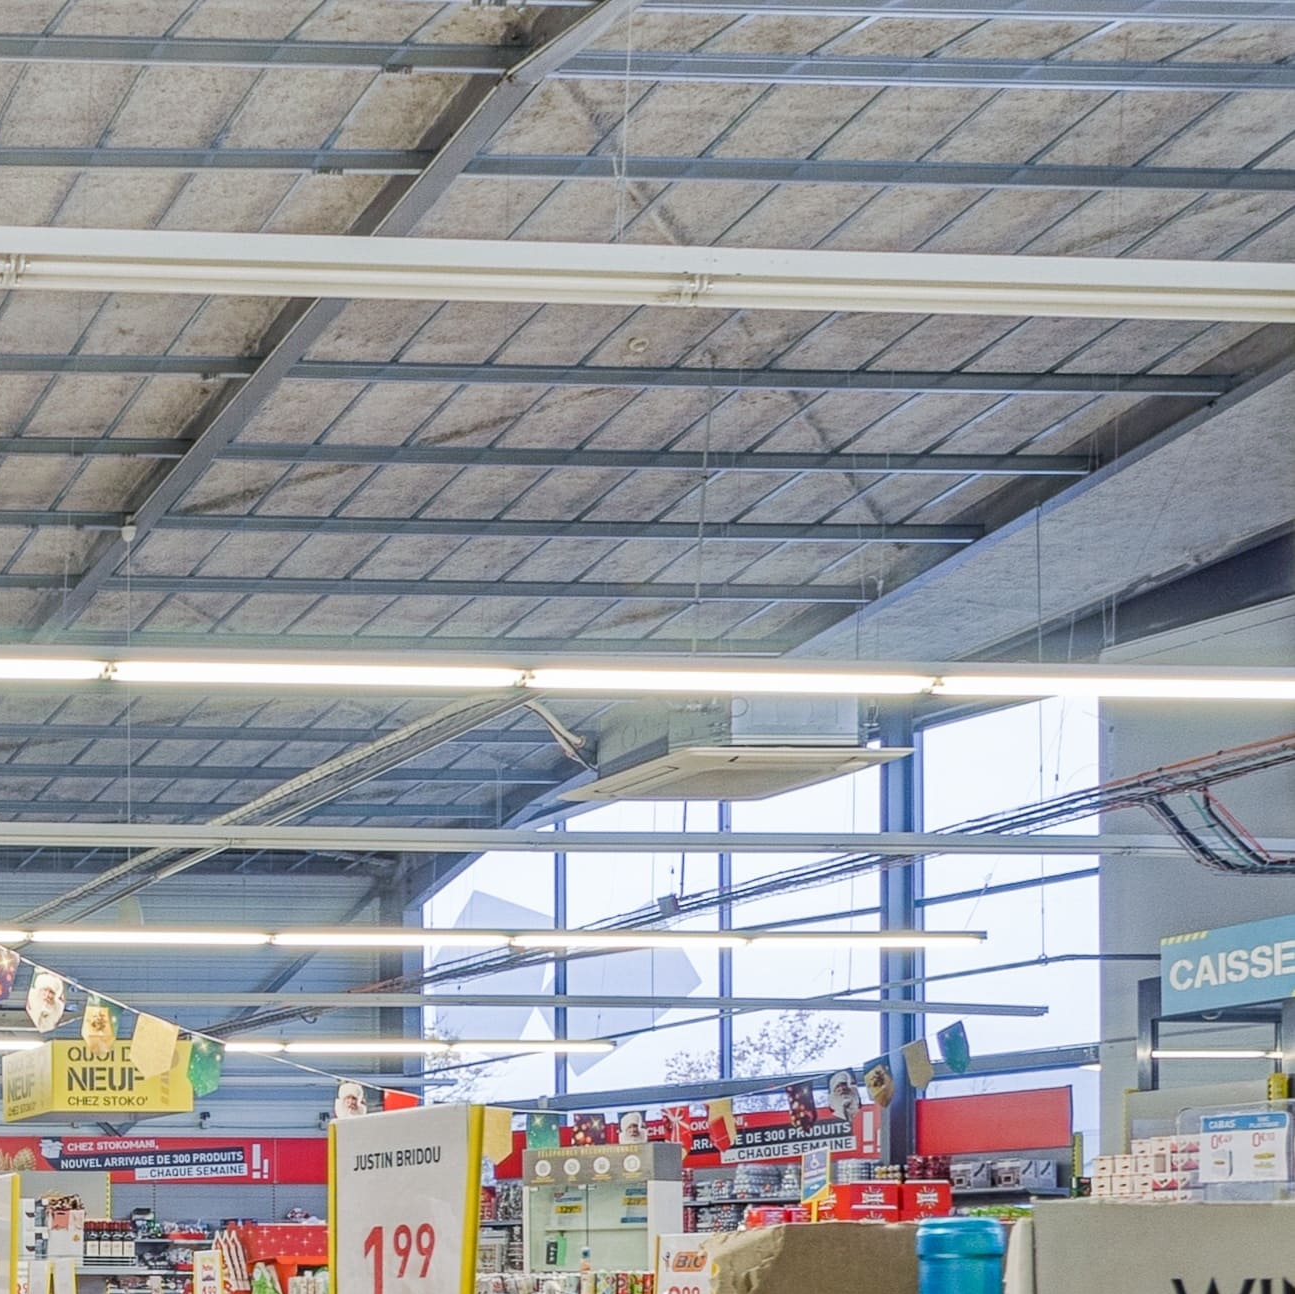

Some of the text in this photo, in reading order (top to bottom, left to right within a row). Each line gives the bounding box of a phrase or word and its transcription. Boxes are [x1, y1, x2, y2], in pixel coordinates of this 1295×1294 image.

[67, 1067, 145, 1091] NEUF
[67, 1096, 100, 1106] CHEZ
[746, 1132, 763, 1145] DE
[764, 1129, 786, 1142] 300
[67, 1141, 94, 1152] CHEZ
[738, 1144, 789, 1161] CHAQUE
[61, 1151, 244, 1169] NOUVEL ARRIVAGE DE 300 PRODUITS
[353, 1146, 442, 1172] JUSTIN BRIDOU
[150, 1166, 245, 1179] CHAQUE SEMAINE
